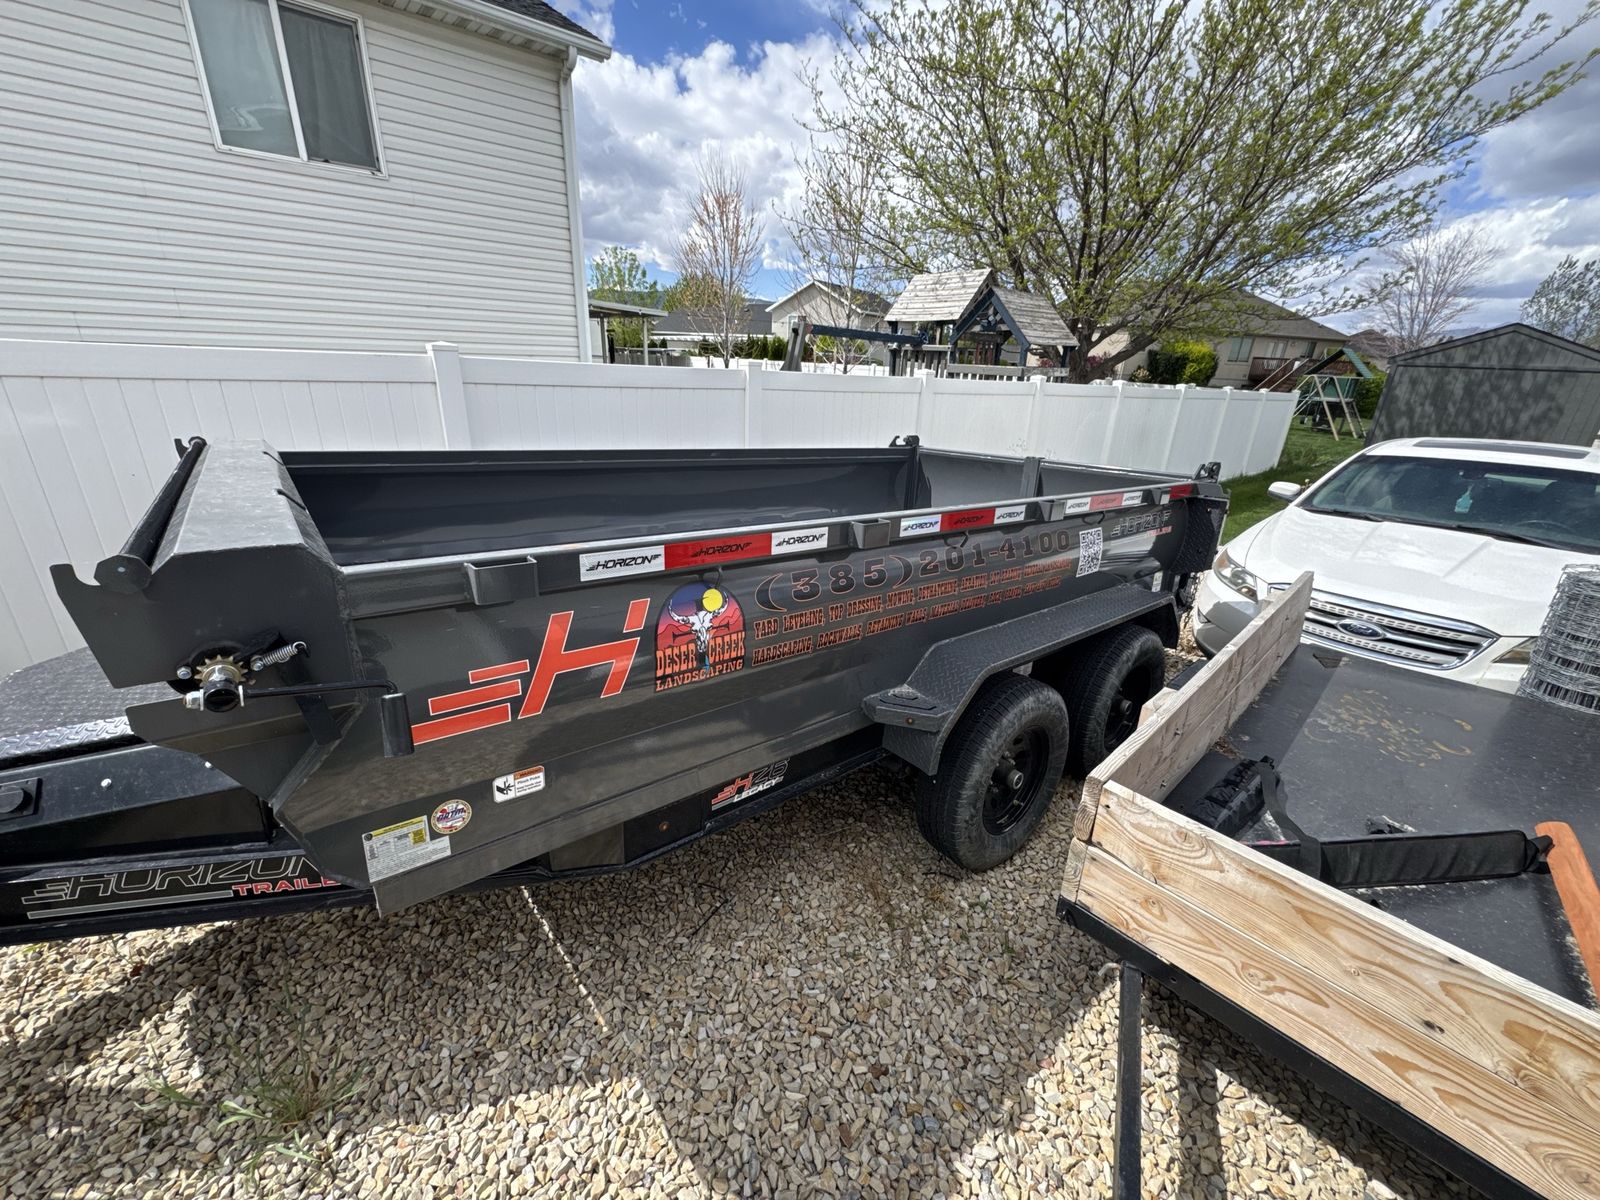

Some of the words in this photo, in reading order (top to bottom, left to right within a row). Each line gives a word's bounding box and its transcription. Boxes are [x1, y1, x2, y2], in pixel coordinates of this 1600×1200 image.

[902, 520, 939, 532] HORIZON
[691, 542, 753, 558] HORIZON
[775, 533, 827, 547] HORIZON
[586, 553, 662, 572] HORIZON
[754, 617, 779, 639] YARD
[783, 608, 825, 633] LEVELING,
[829, 603, 845, 622] TOP
[847, 595, 884, 618] DRESSING,
[656, 640, 701, 677] DESER
[708, 630, 745, 664] CREEK
[752, 636, 814, 666] HARDSCAPING,
[655, 659, 743, 692] LANDSCAPING
